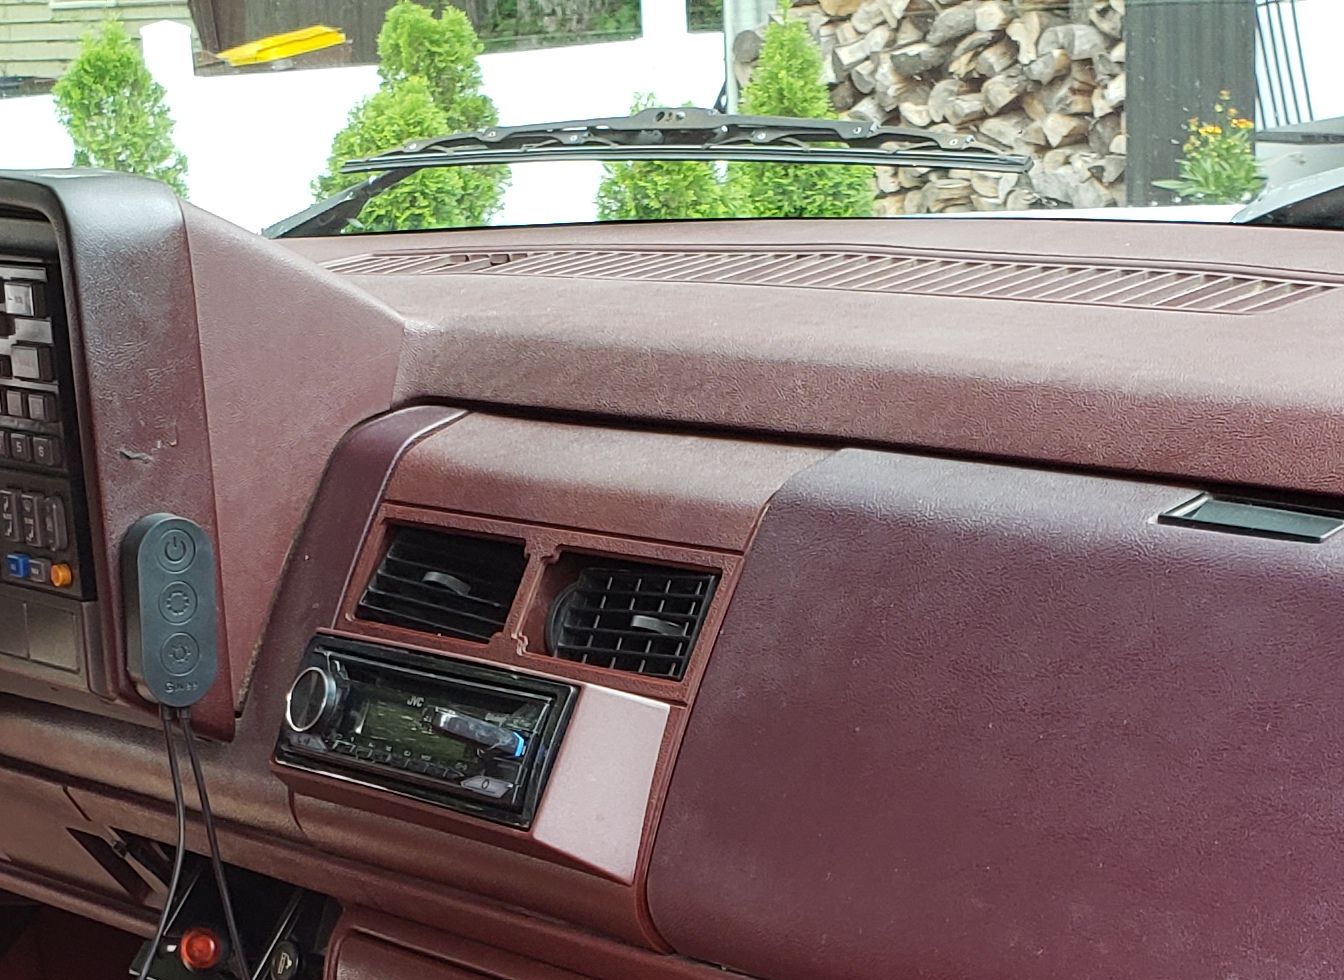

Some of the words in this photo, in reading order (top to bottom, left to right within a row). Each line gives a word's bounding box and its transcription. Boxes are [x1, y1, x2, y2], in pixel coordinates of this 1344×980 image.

[16, 441, 23, 454] 5
[38, 445, 46, 458] 6
[406, 695, 425, 708] JVC
